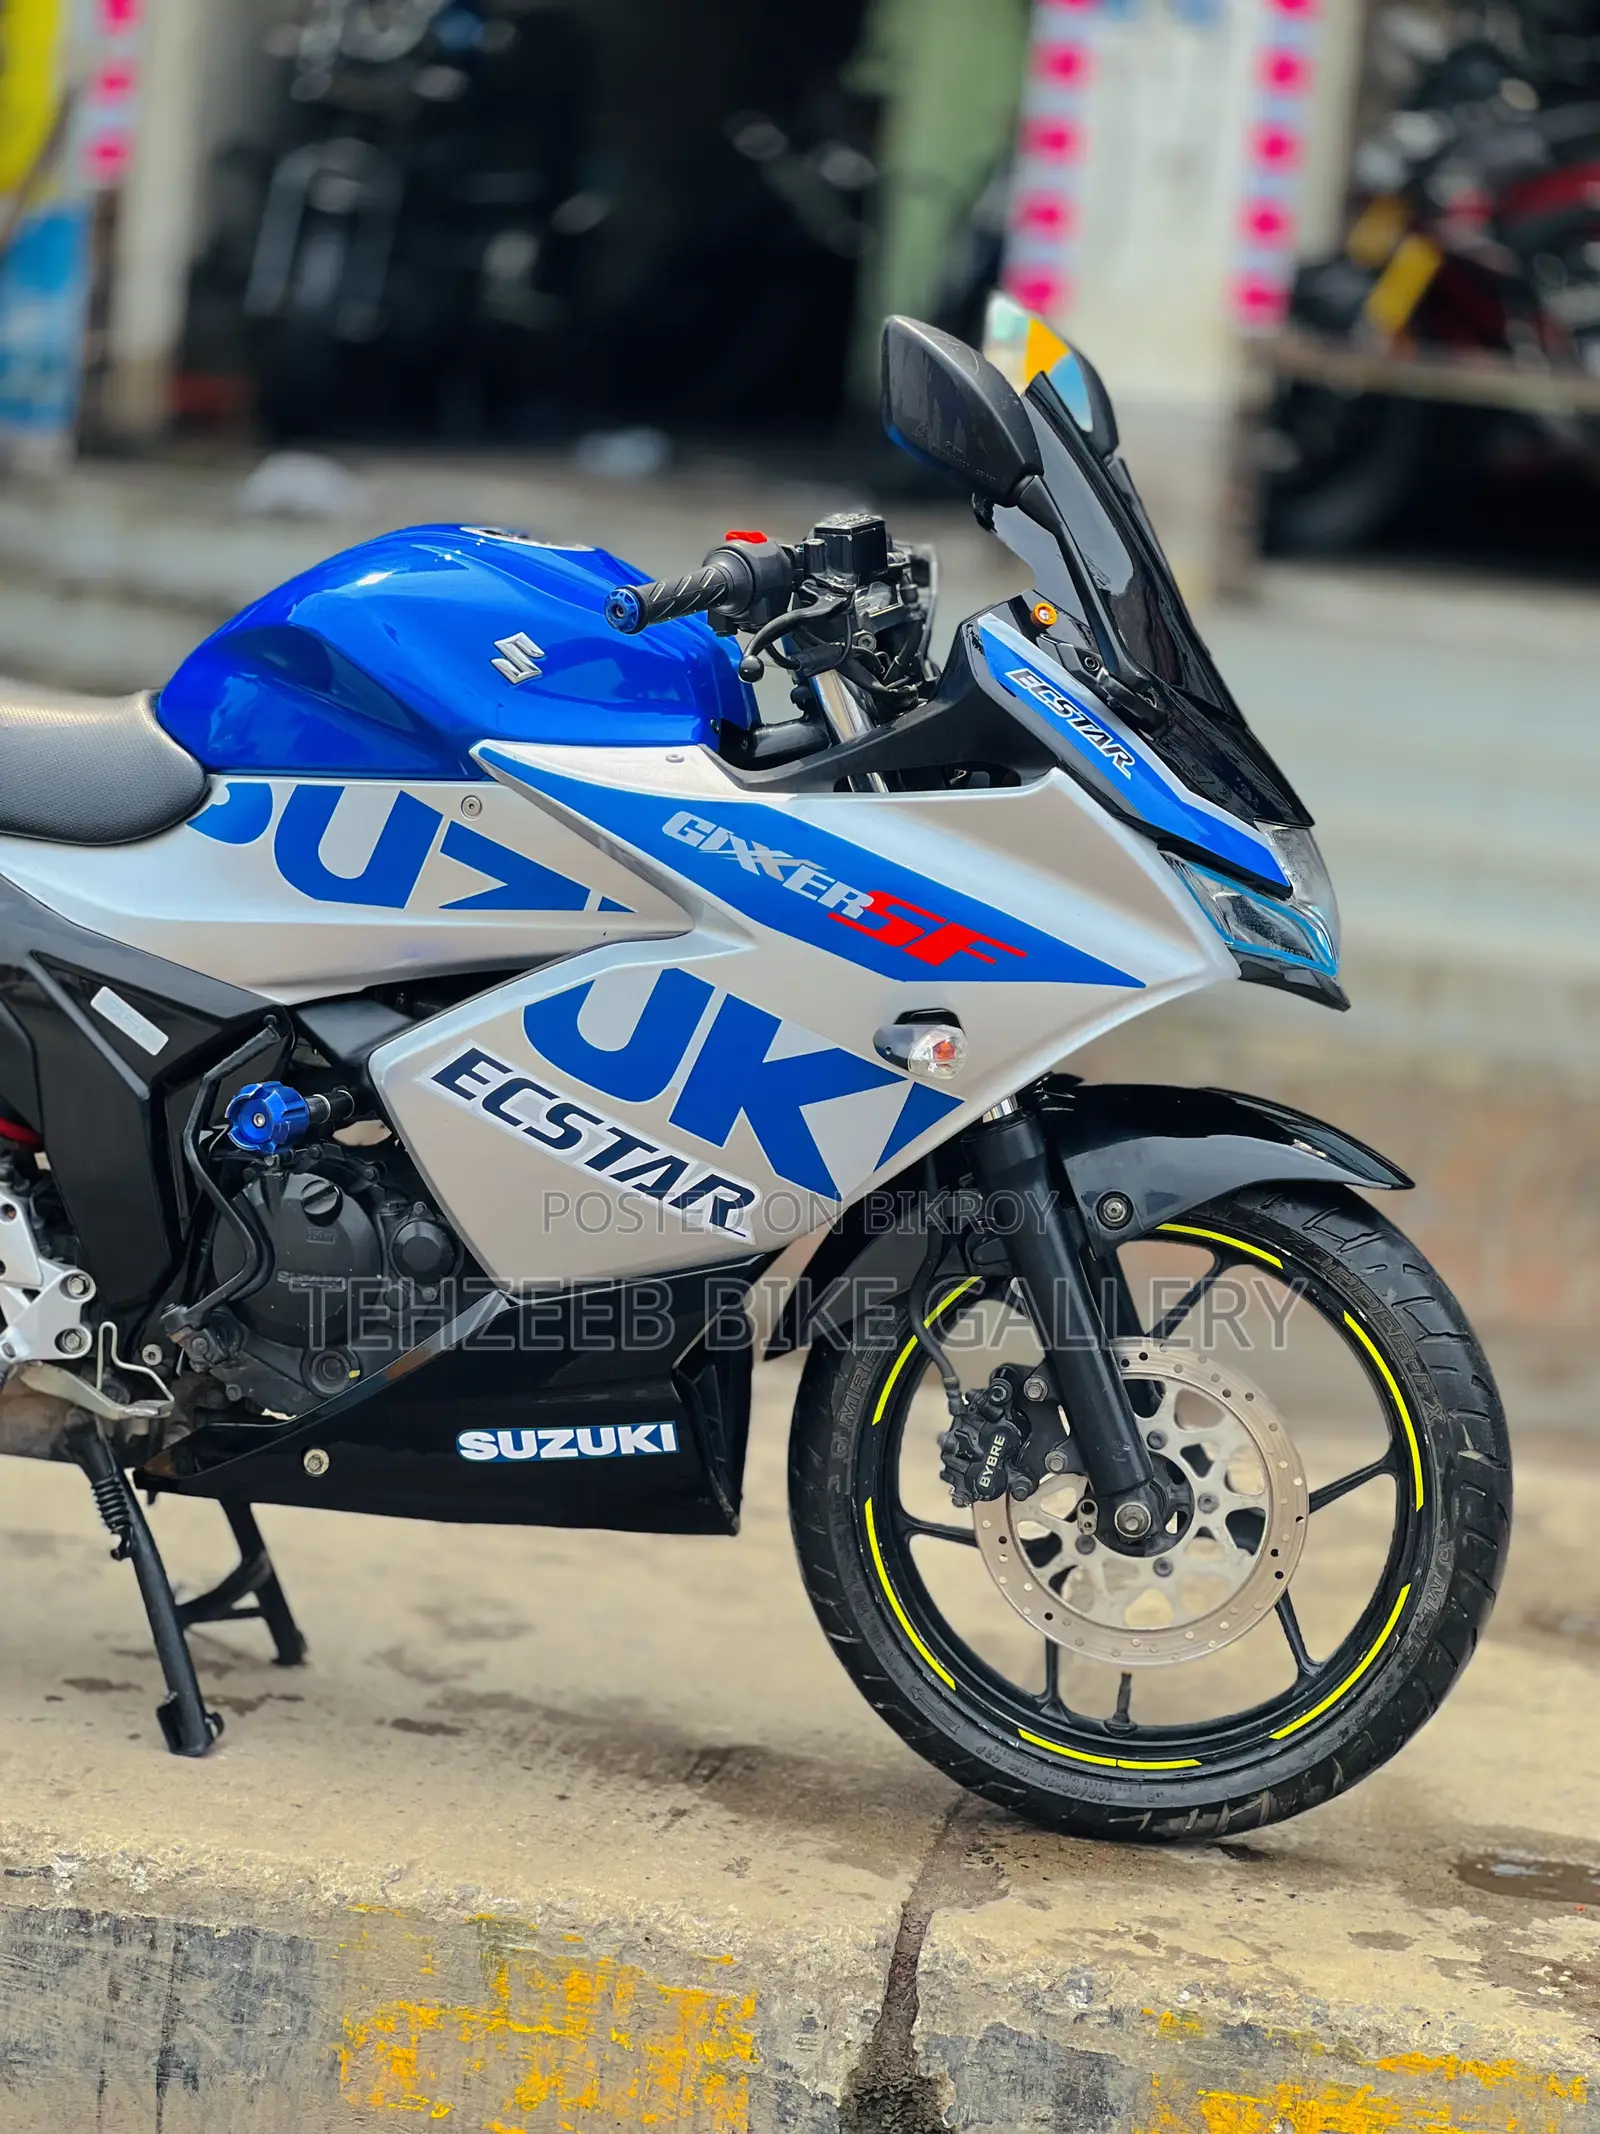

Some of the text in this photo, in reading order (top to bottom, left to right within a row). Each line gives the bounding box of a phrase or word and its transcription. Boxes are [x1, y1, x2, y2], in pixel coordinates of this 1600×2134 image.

[1004, 667, 1135, 780] ECSTAR
[662, 811, 1027, 966] GIXXER SF
[430, 1046, 762, 1238] ECSTAR
[458, 1423, 677, 1461] SUZUKI
[979, 1435, 1005, 1487] BYBRE
